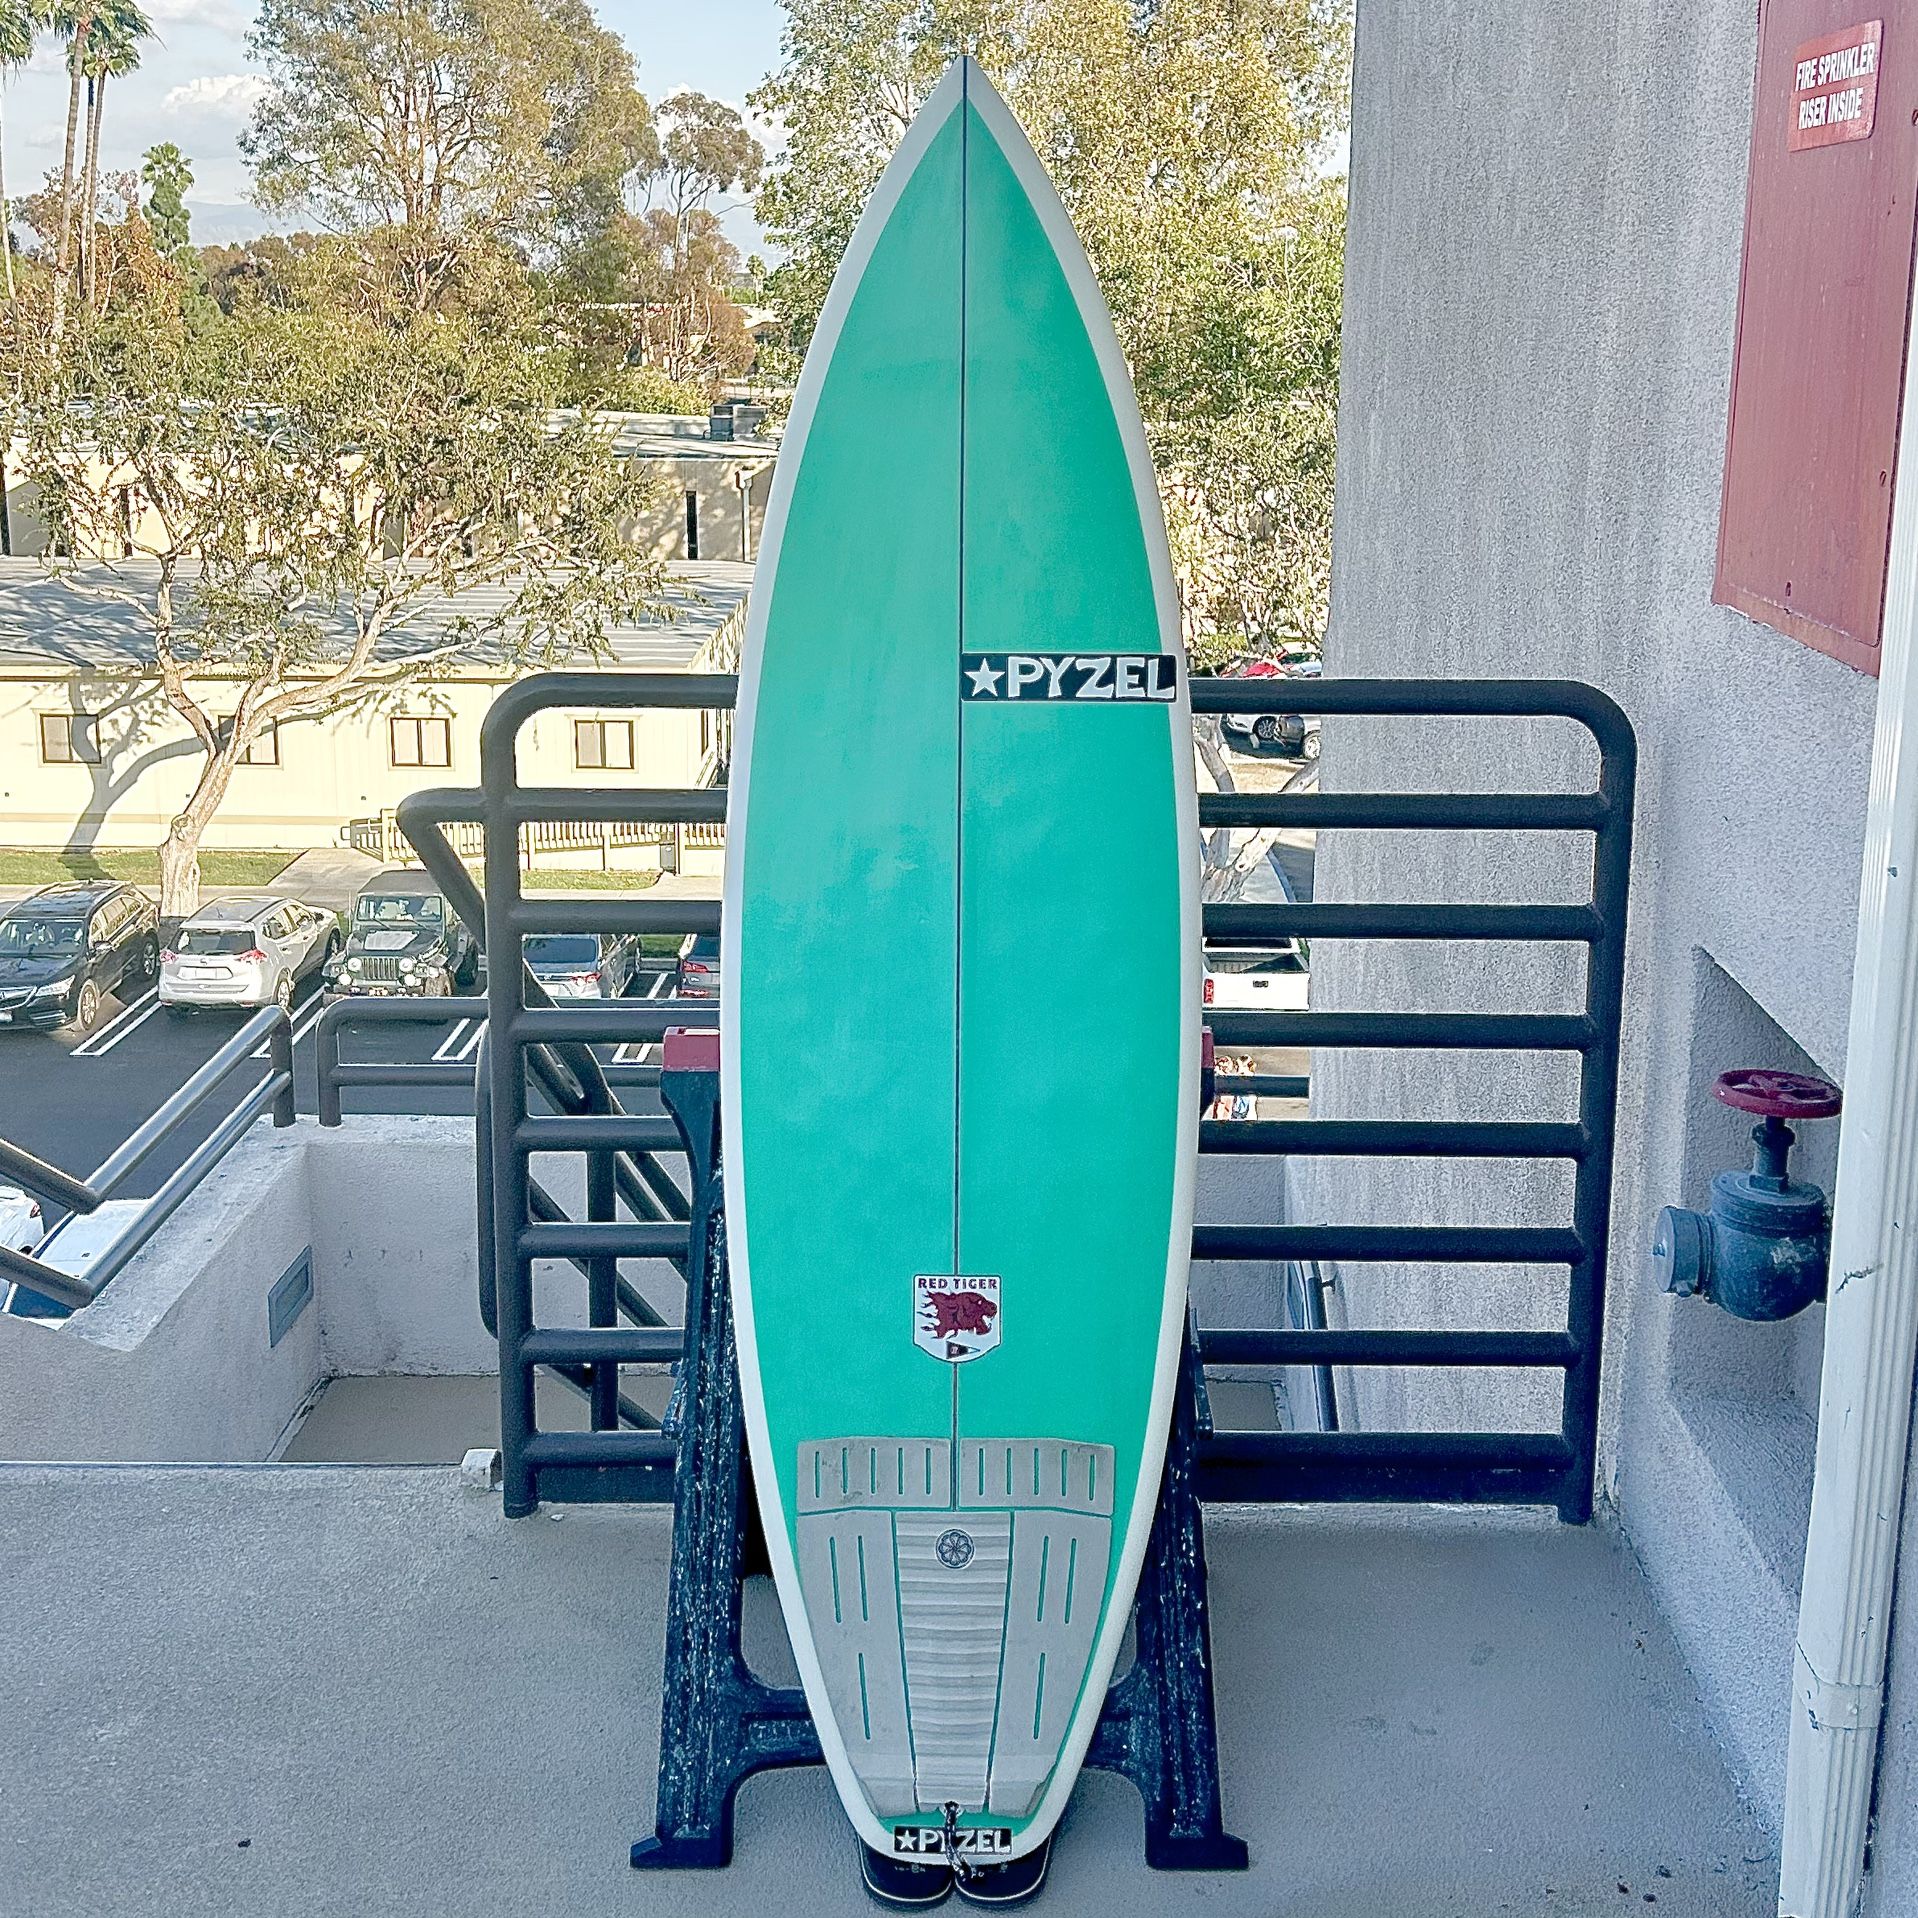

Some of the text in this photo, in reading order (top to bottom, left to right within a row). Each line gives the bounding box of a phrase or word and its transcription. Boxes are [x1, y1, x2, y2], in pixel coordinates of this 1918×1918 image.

[1795, 42, 1875, 92] FIRE SPRINKLER
[1798, 87, 1864, 130] RISER INSIDE
[1007, 655, 1176, 699] PYZEL
[918, 1277, 997, 1290] RED TIGER
